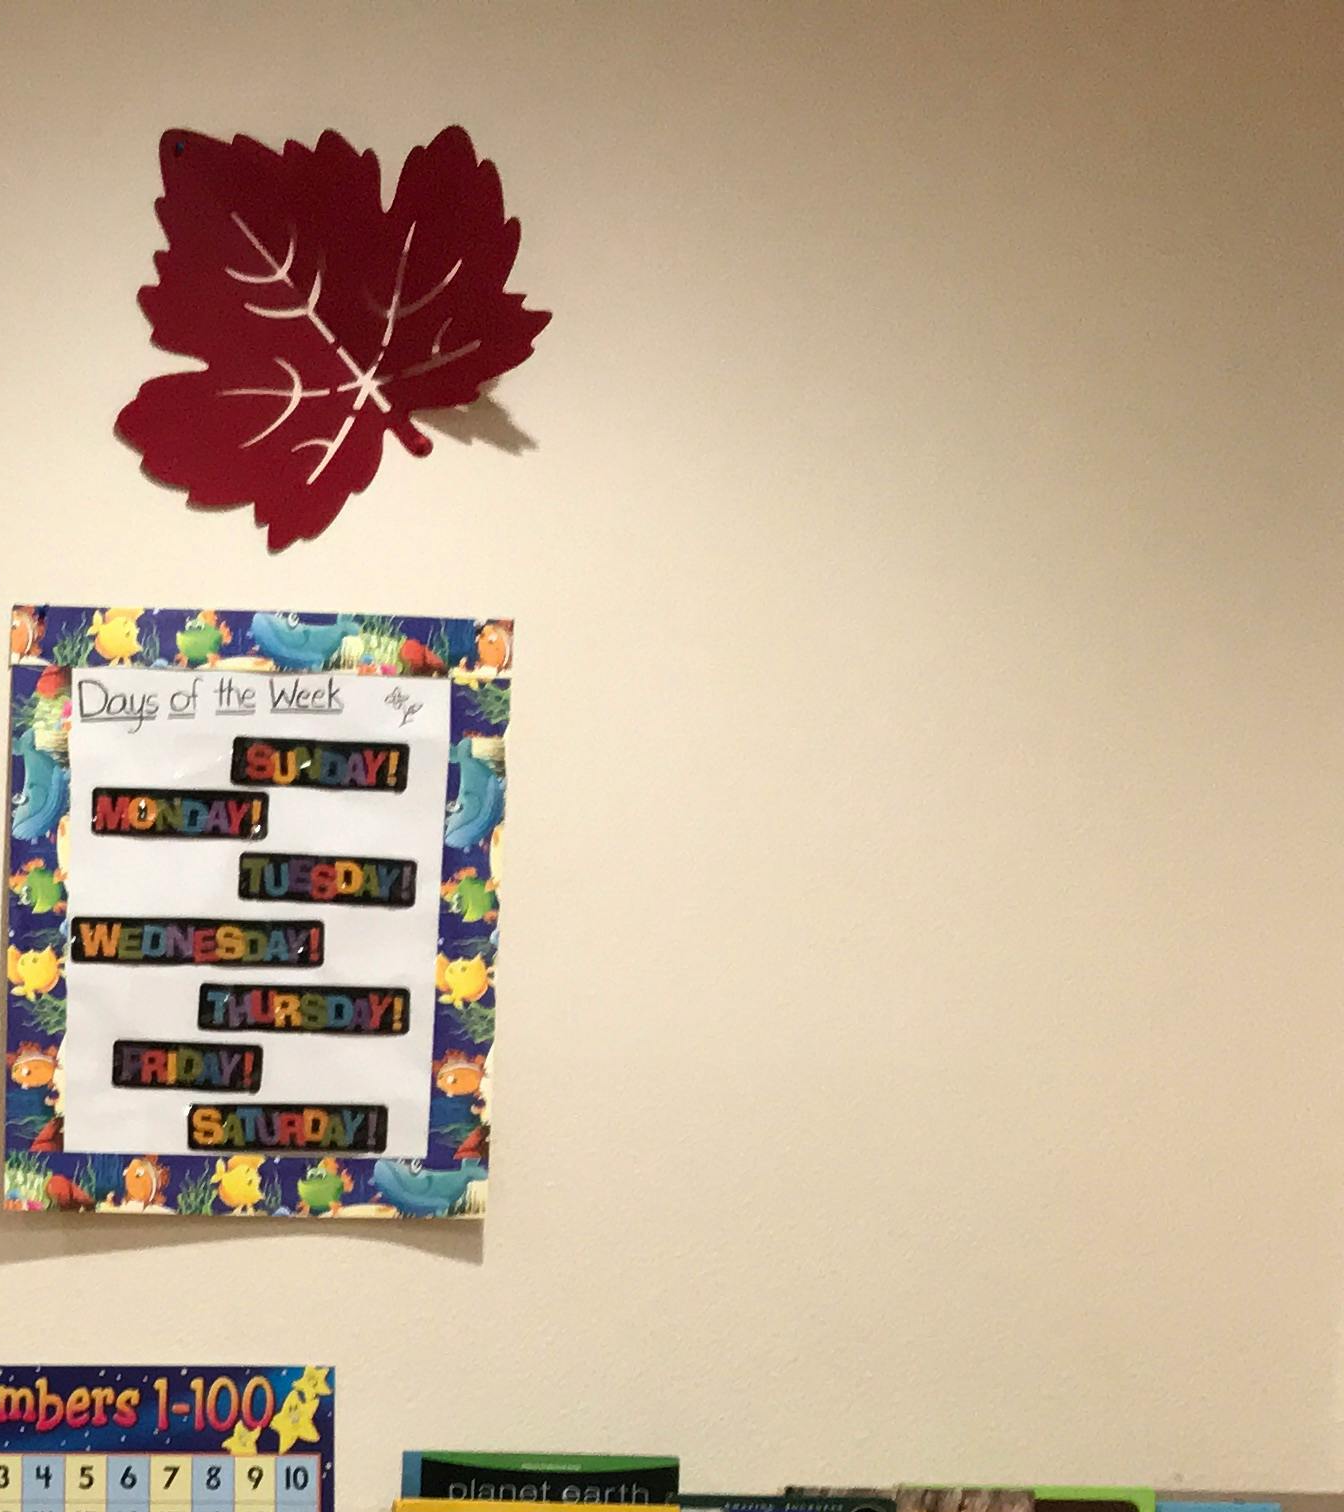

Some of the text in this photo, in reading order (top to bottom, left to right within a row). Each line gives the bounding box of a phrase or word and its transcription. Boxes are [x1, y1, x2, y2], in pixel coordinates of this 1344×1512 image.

[79, 677, 341, 733] Days of the Week
[246, 744, 399, 787] SUNDAY!
[94, 794, 263, 835] MONDAY!
[242, 858, 411, 896] TUESDAY!
[79, 923, 320, 961] WEDNESDAY!
[207, 991, 405, 1030] THURSDAY!
[121, 1047, 255, 1087] FRIDAY!
[191, 1110, 380, 1149] SATURDAY!
[153, 1375, 275, 1434] 1-100
[35, 1466, 53, 1490] 4
[78, 1466, 95, 1490] 5
[119, 1466, 138, 1490] 6
[162, 1466, 181, 1490] 7
[205, 1466, 222, 1491] 8
[247, 1466, 264, 1491] 9
[284, 1466, 309, 1491] 10
[448, 1478, 650, 1504] planet earth
